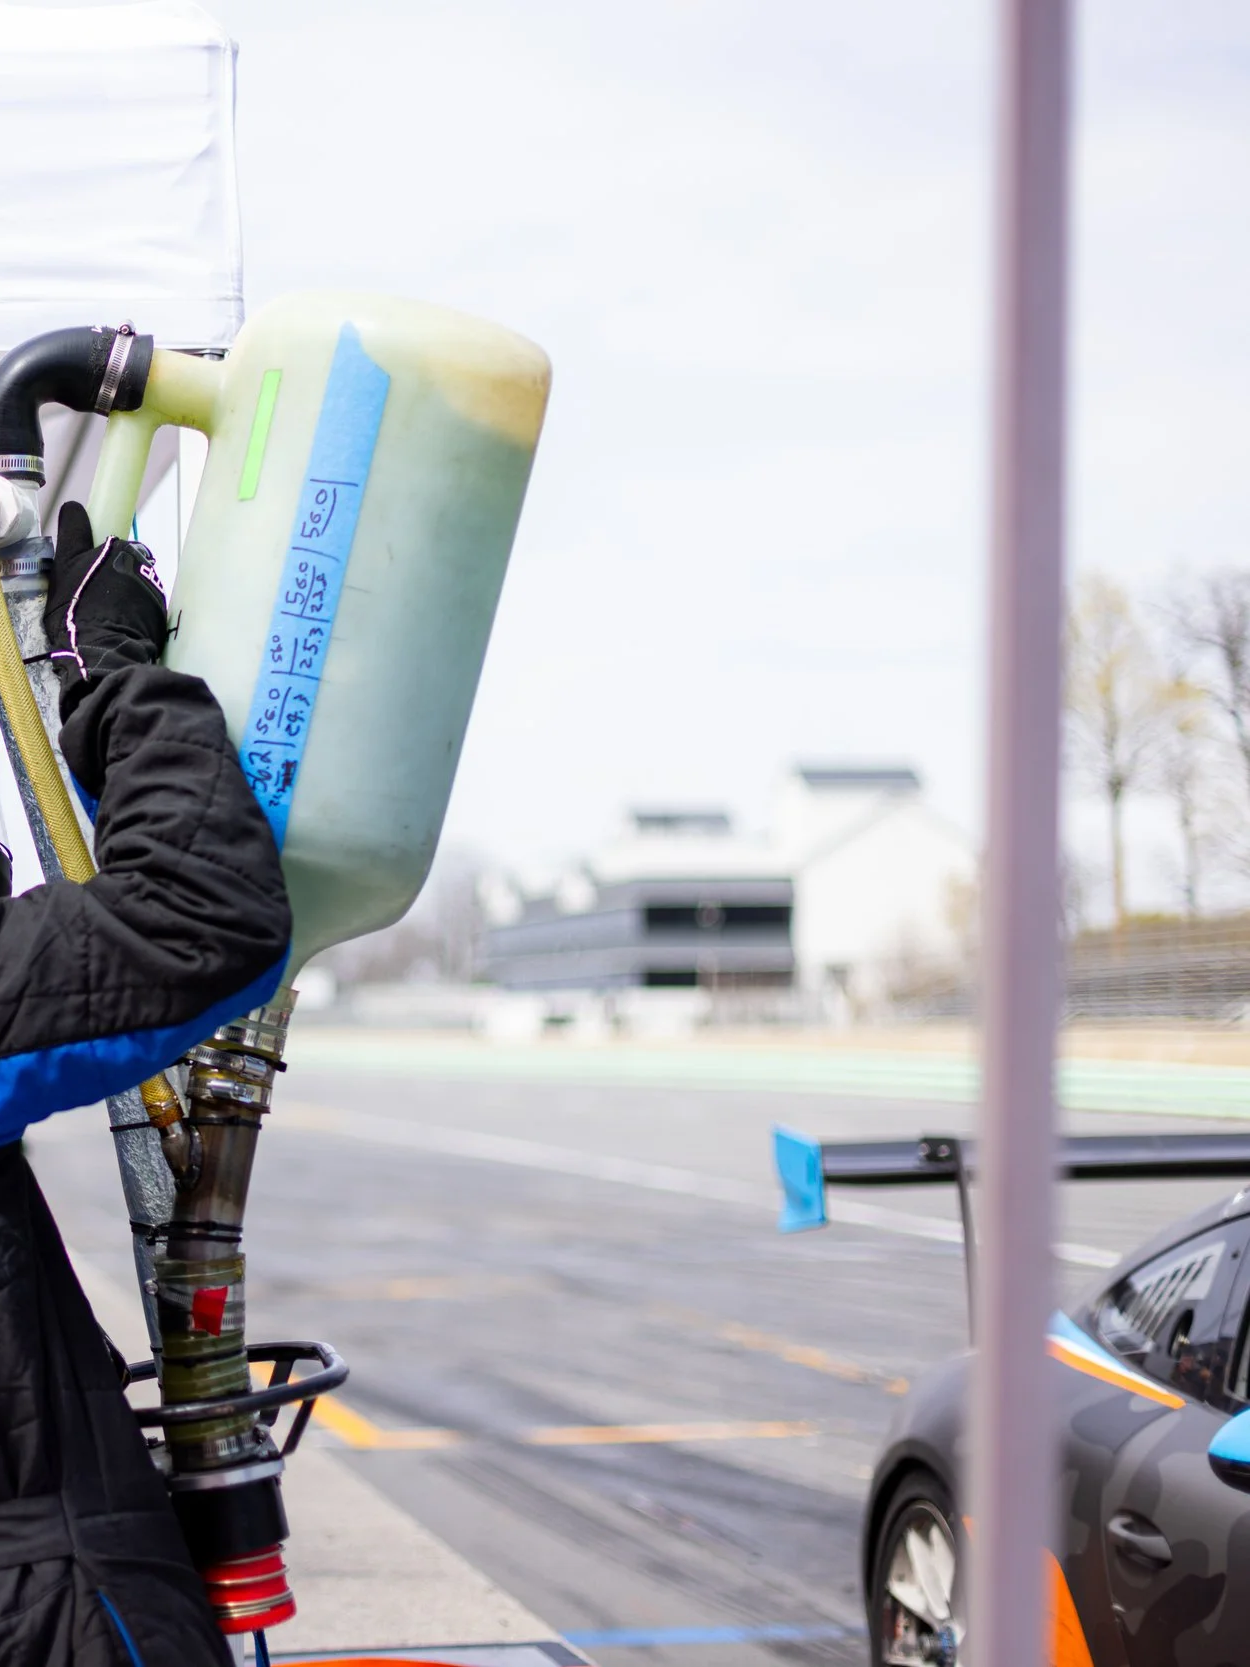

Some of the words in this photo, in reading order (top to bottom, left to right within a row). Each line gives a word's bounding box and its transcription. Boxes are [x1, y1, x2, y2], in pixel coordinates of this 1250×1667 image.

[285, 562, 309, 605] 56.0
[300, 488, 328, 539] 56.0
[299, 627, 324, 669] 25.3
